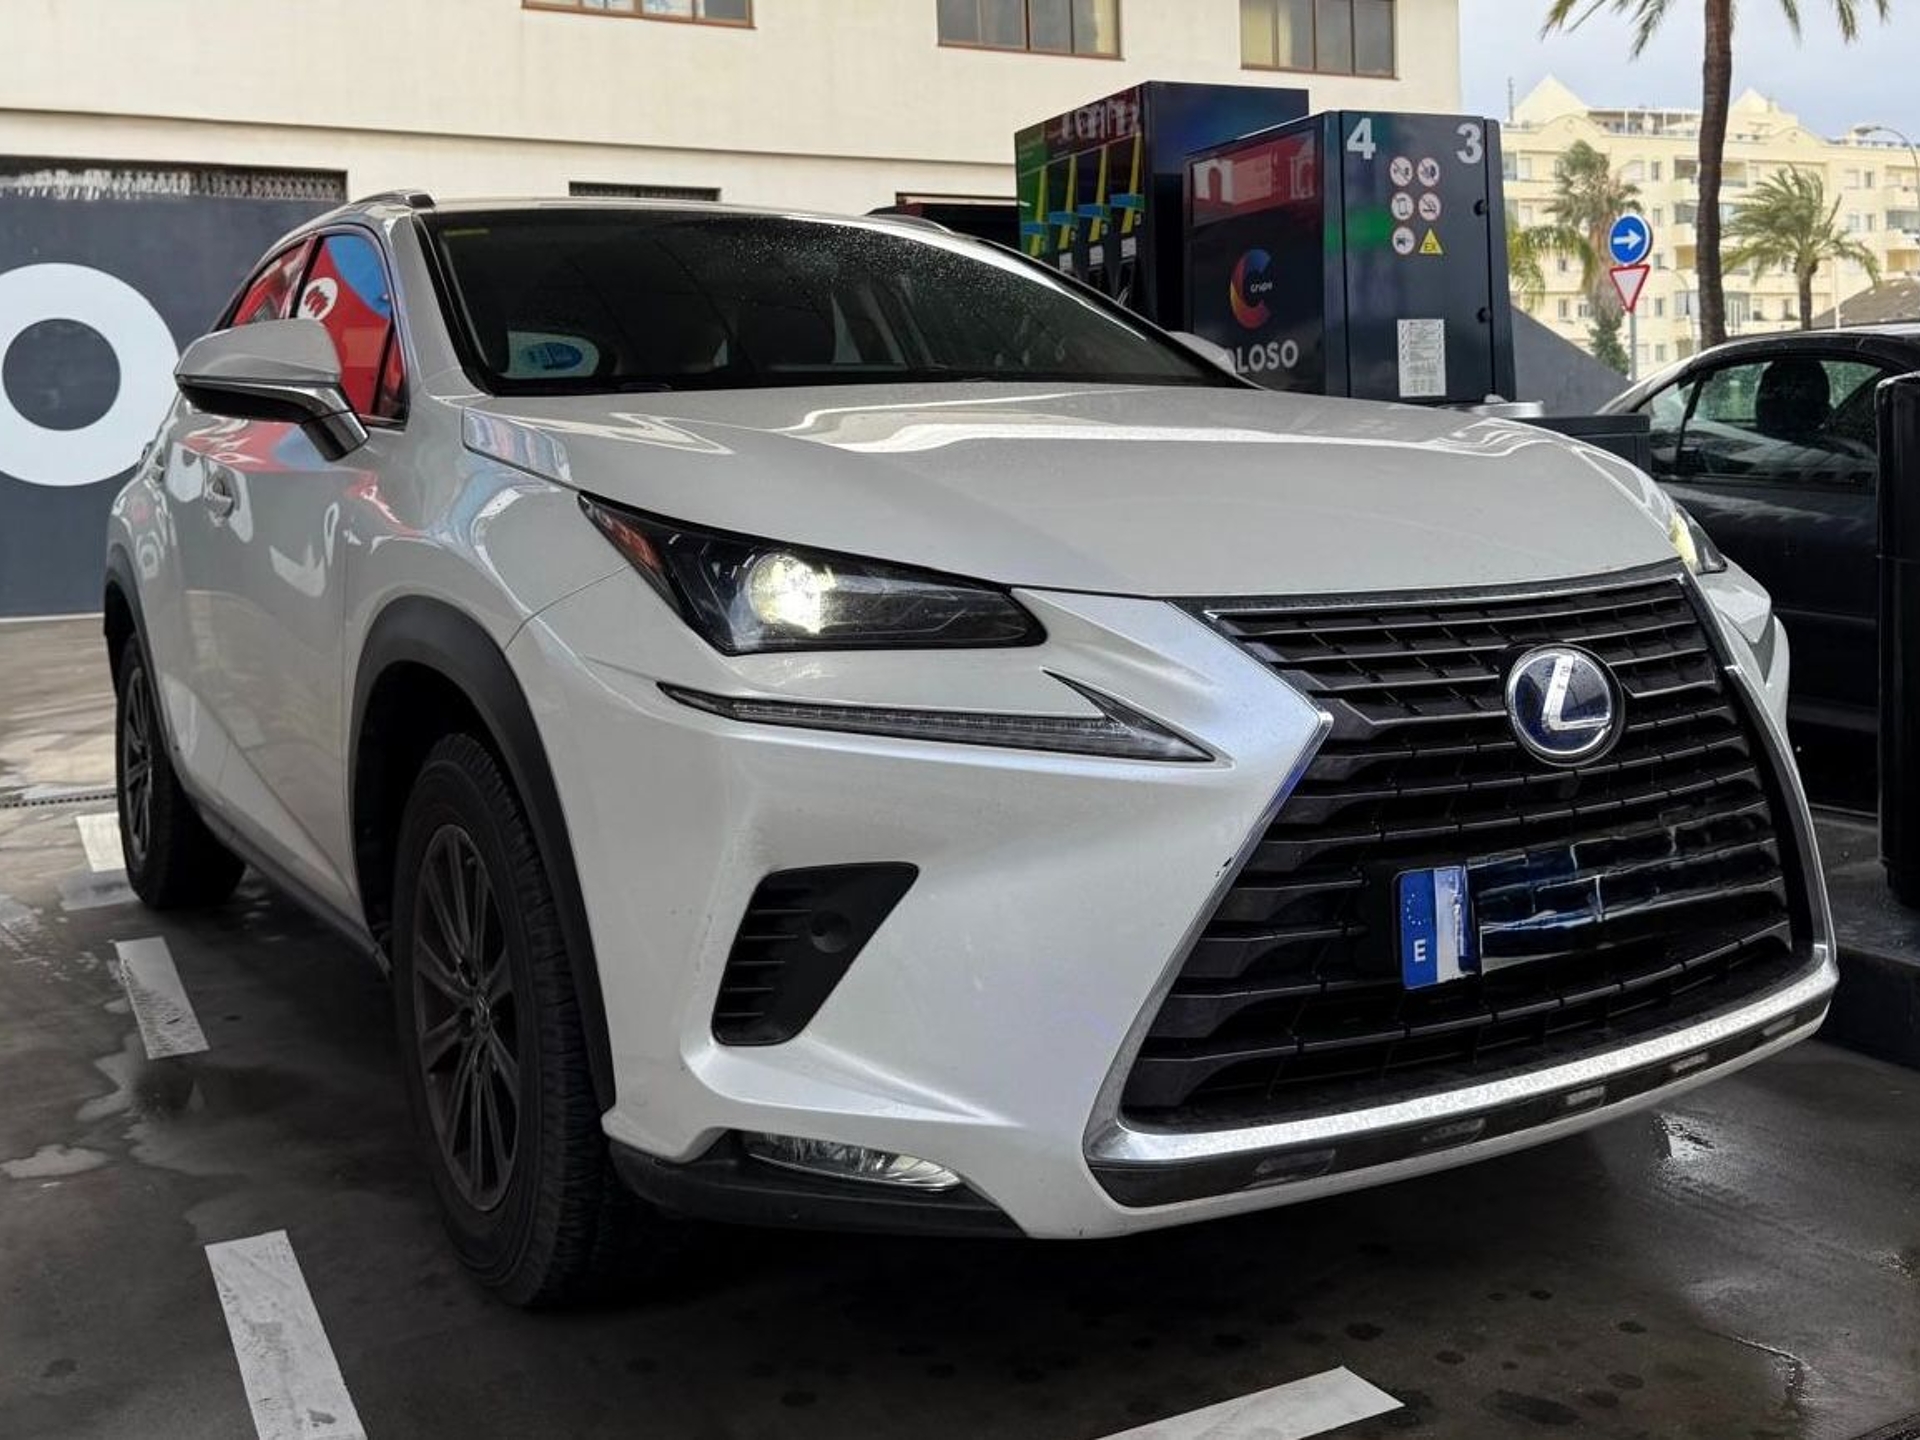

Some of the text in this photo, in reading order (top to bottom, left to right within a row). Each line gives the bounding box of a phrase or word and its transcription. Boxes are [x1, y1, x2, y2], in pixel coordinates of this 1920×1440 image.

[1347, 118, 1376, 160] 4
[1457, 123, 1482, 164] 3
[1414, 939, 1426, 962] E
